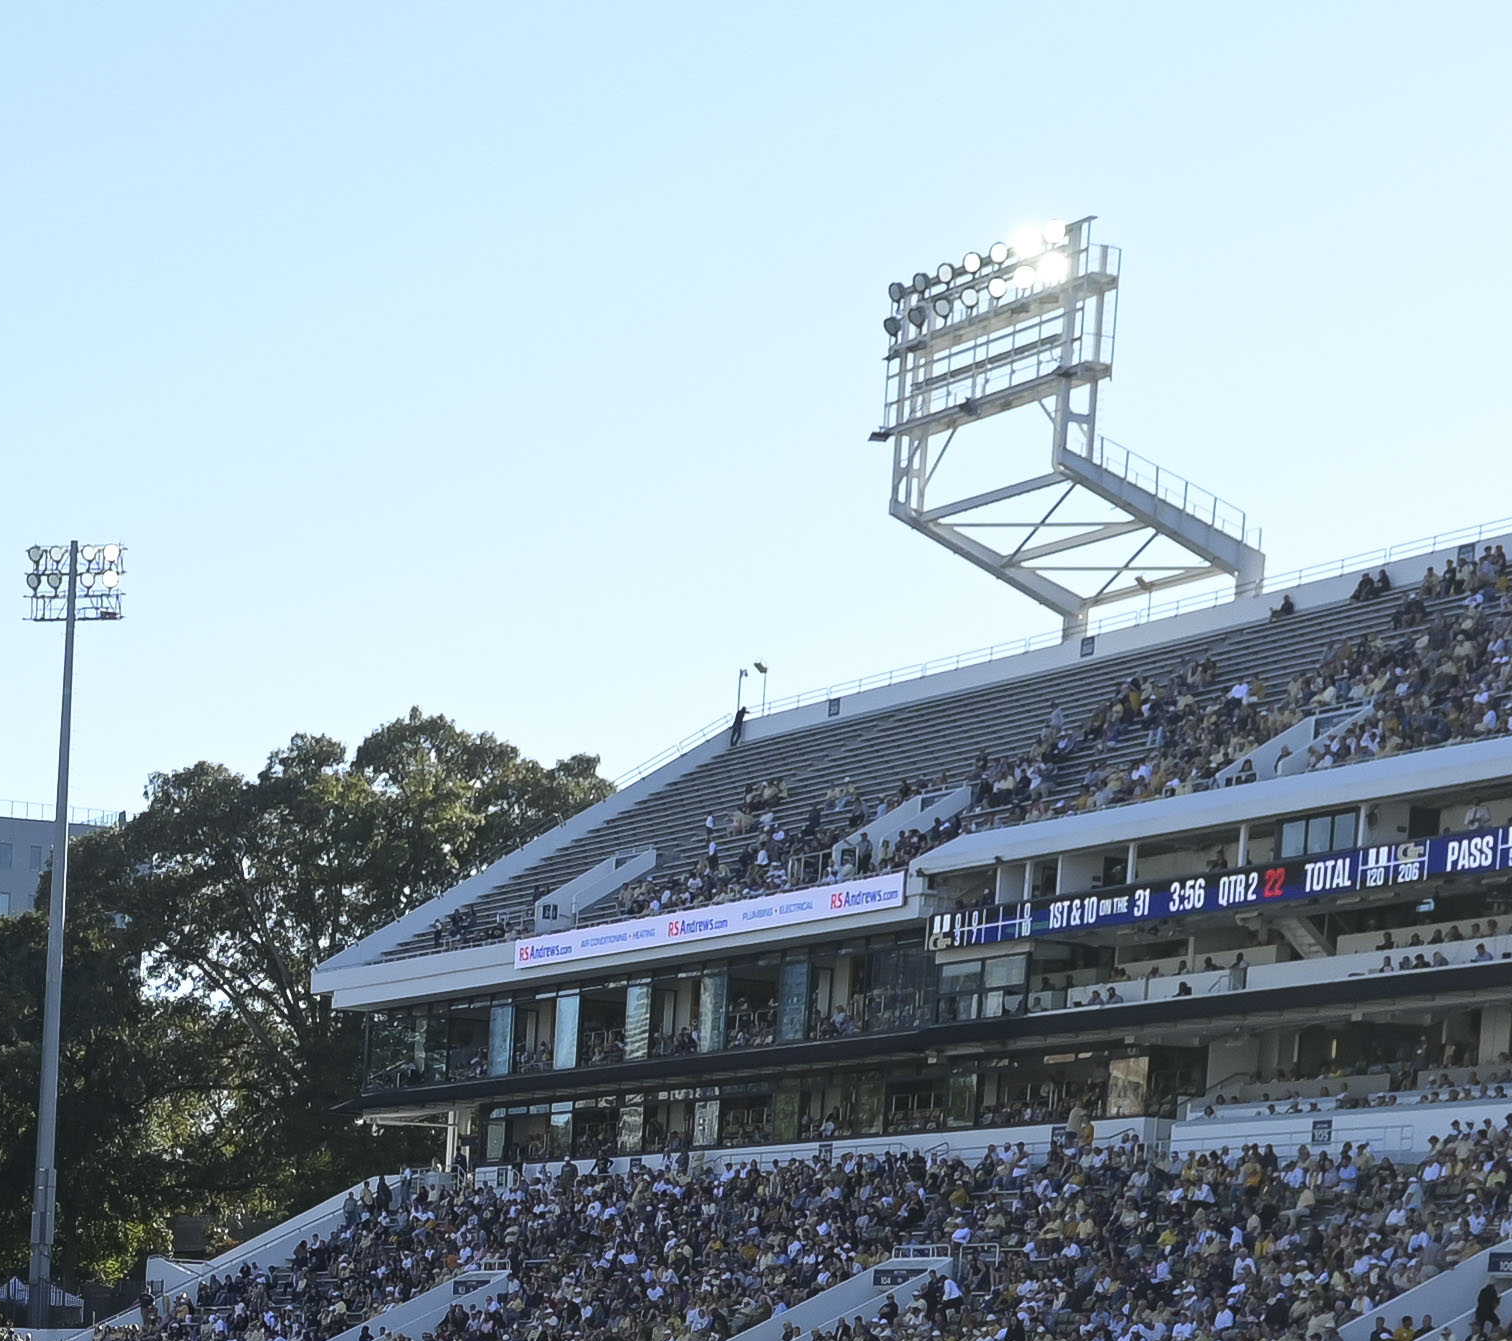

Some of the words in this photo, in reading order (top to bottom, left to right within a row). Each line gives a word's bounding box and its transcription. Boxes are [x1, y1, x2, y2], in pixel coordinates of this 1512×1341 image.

[1446, 836, 1493, 873] PASS
[1305, 858, 1351, 893] TOTAL
[1366, 868, 1384, 887] 120
[1397, 862, 1420, 884] 206
[1049, 900, 1069, 929] 1ST
[1083, 897, 1097, 924] 10
[1133, 888, 1151, 917] 31
[1169, 878, 1205, 912] 3:56
[1218, 874, 1246, 906] QTR
[1247, 871, 1259, 901] 2
[1264, 867, 1287, 898] 22
